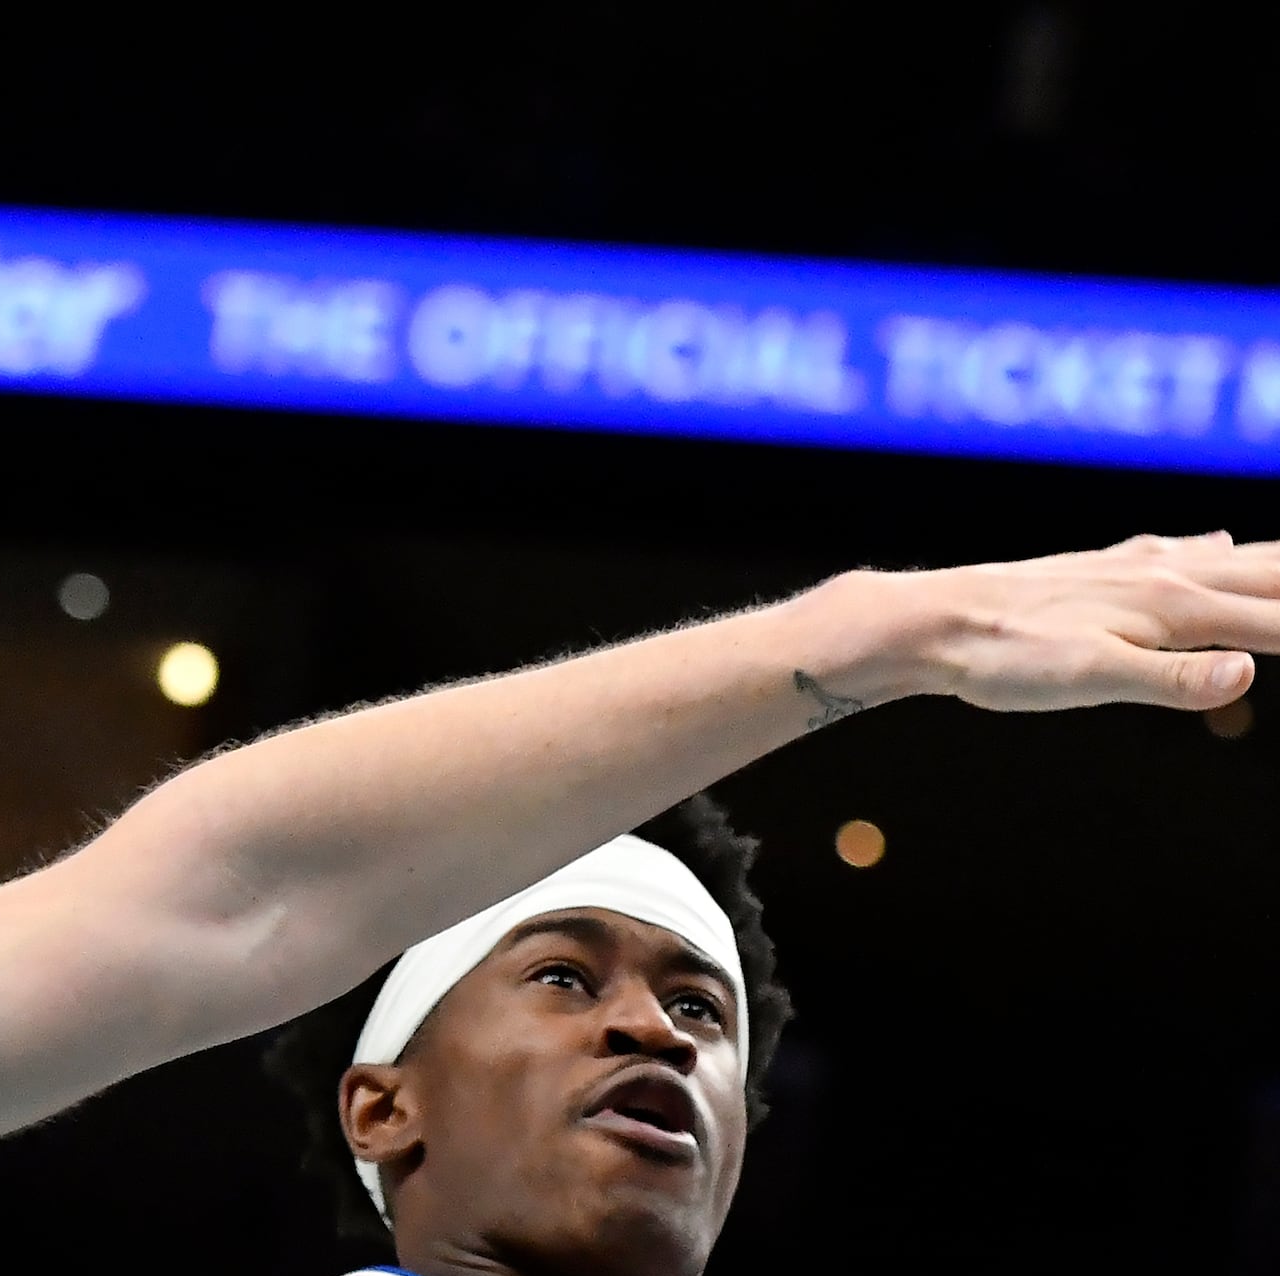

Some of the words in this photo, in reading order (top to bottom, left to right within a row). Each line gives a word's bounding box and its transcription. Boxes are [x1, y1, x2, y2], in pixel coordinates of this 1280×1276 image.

[204, 270, 398, 384] THE
[408, 284, 866, 416] OFFICIAL
[876, 314, 1226, 438] TICKET
